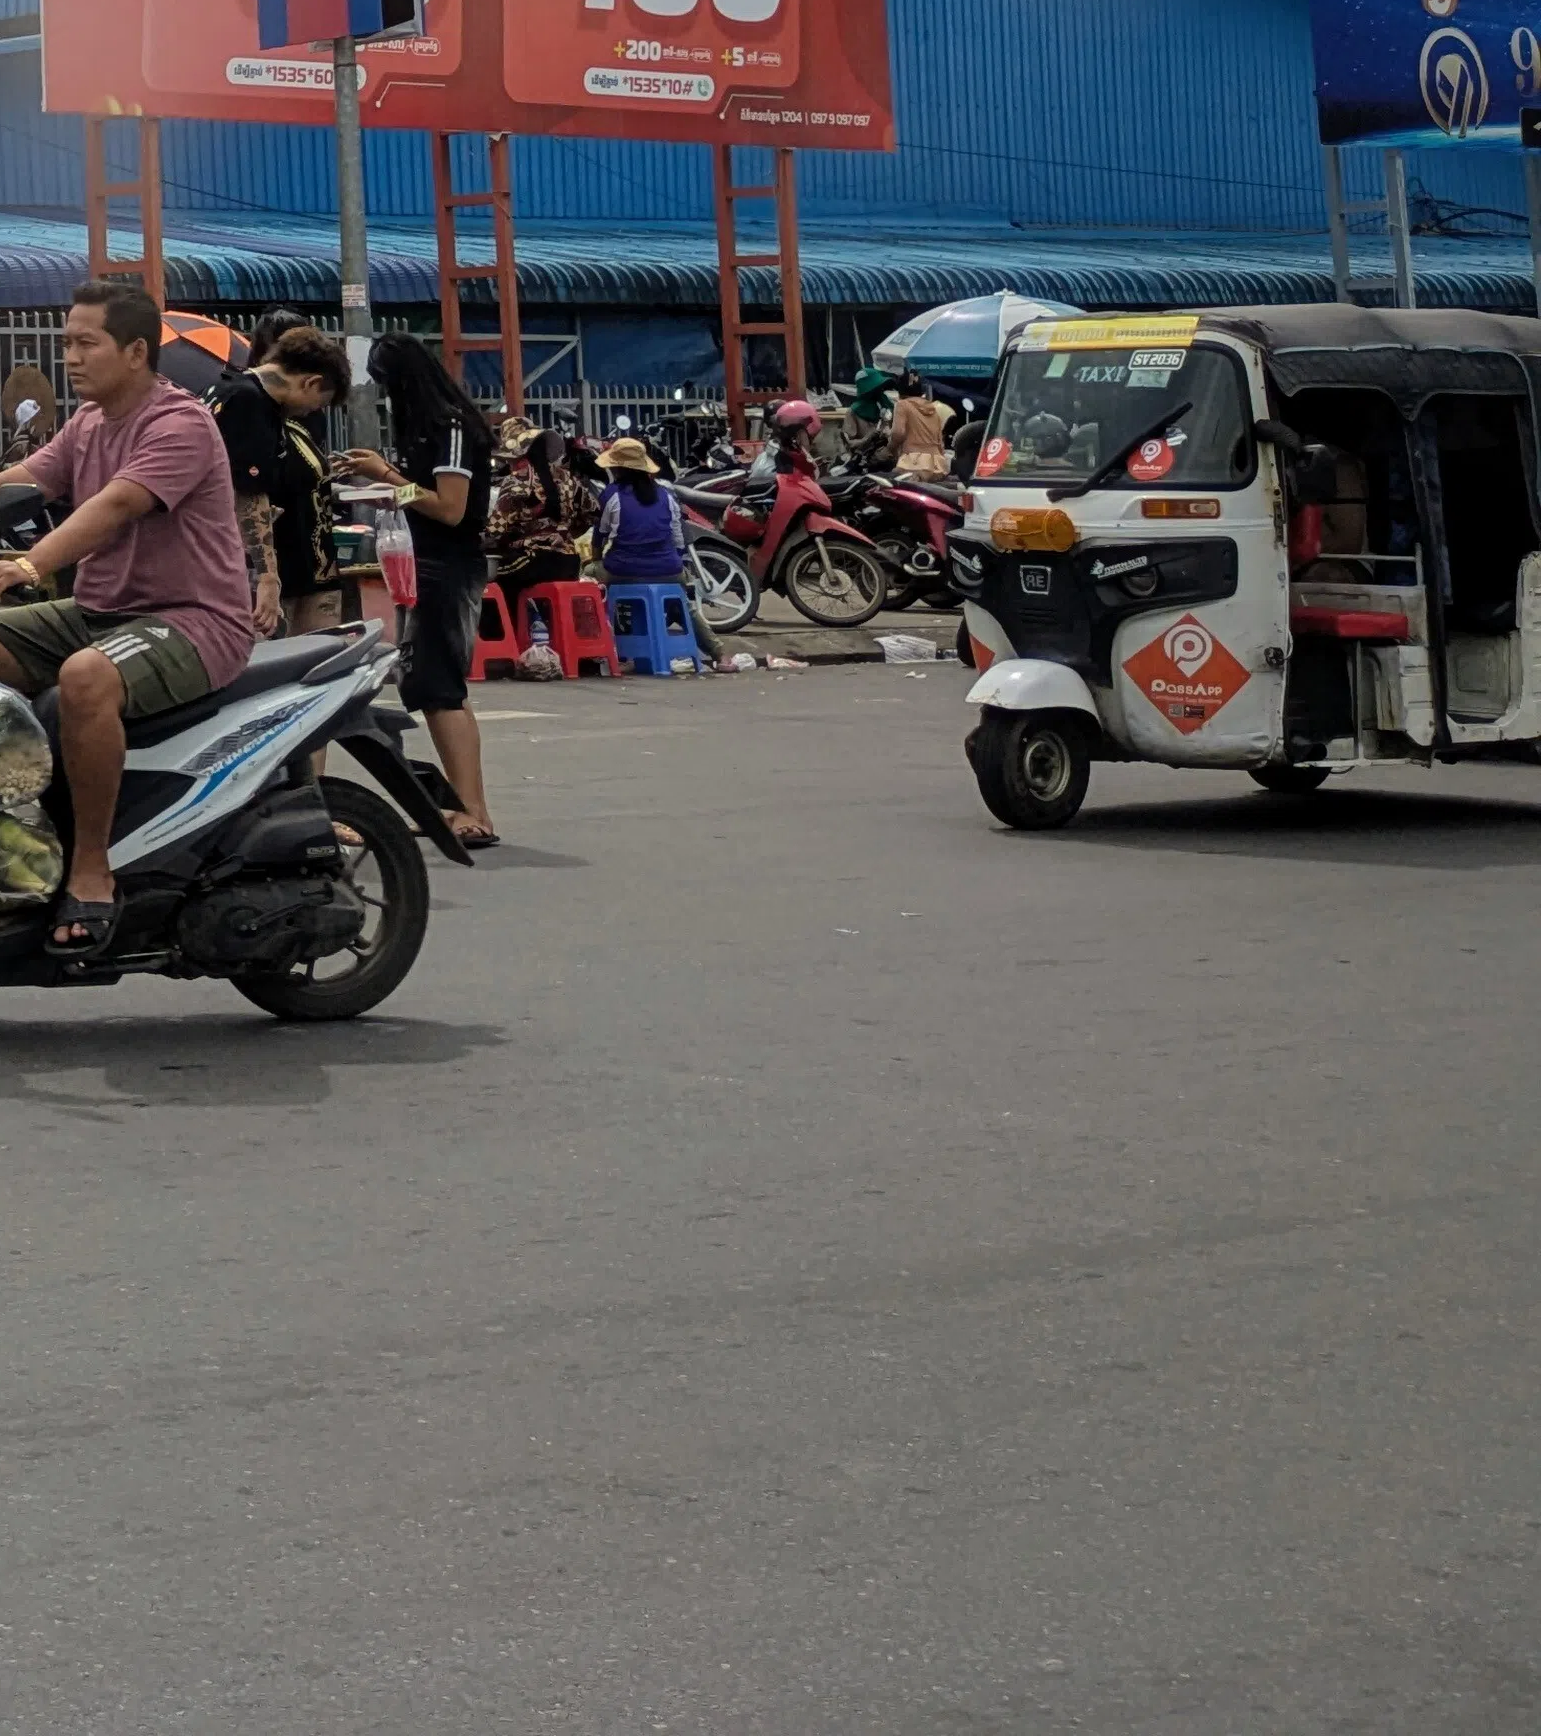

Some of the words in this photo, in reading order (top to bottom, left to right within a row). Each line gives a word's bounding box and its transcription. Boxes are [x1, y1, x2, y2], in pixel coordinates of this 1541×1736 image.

[781, 110, 802, 123] 1204
[811, 112, 828, 124] 097
[829, 113, 836, 124] 9
[836, 114, 853, 125] 097
[854, 115, 870, 126] 097
[1133, 353, 1181, 367] SV2036
[1079, 366, 1124, 383] TAXI
[1026, 574, 1044, 588] RE
[1151, 679, 1223, 696] PassApp
